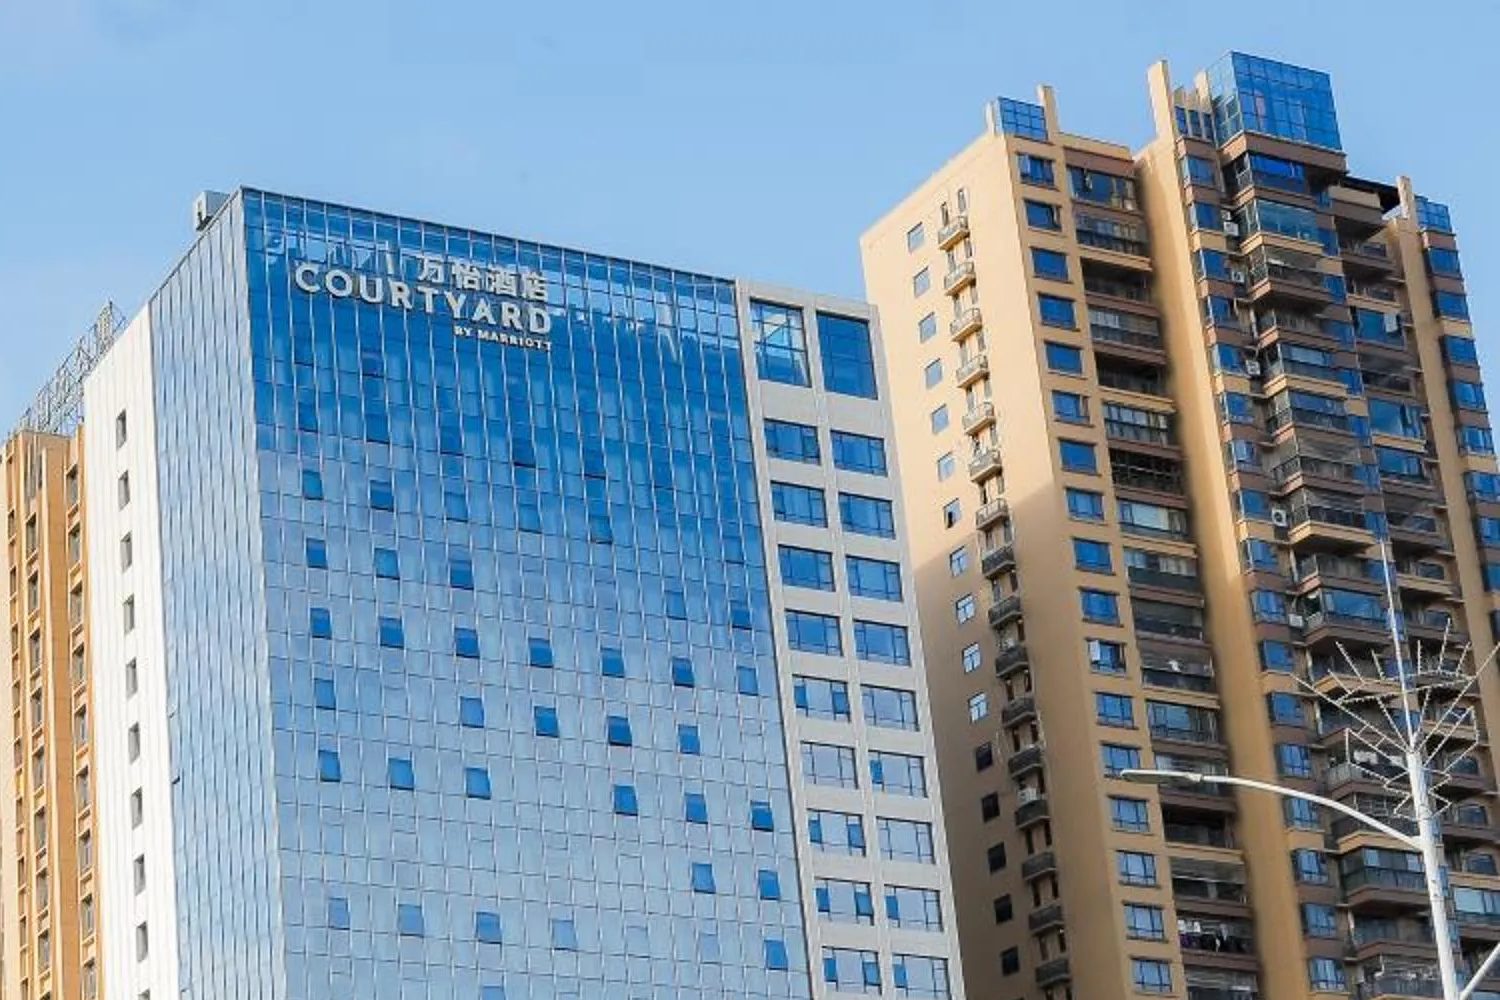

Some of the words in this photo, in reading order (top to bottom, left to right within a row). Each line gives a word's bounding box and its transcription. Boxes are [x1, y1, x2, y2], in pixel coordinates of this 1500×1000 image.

[295, 260, 552, 334] COURTYARD
[417, 254, 549, 300] 万怡酒店
[453, 325, 472, 337] BY
[478, 329, 552, 351] MARRIOTT
